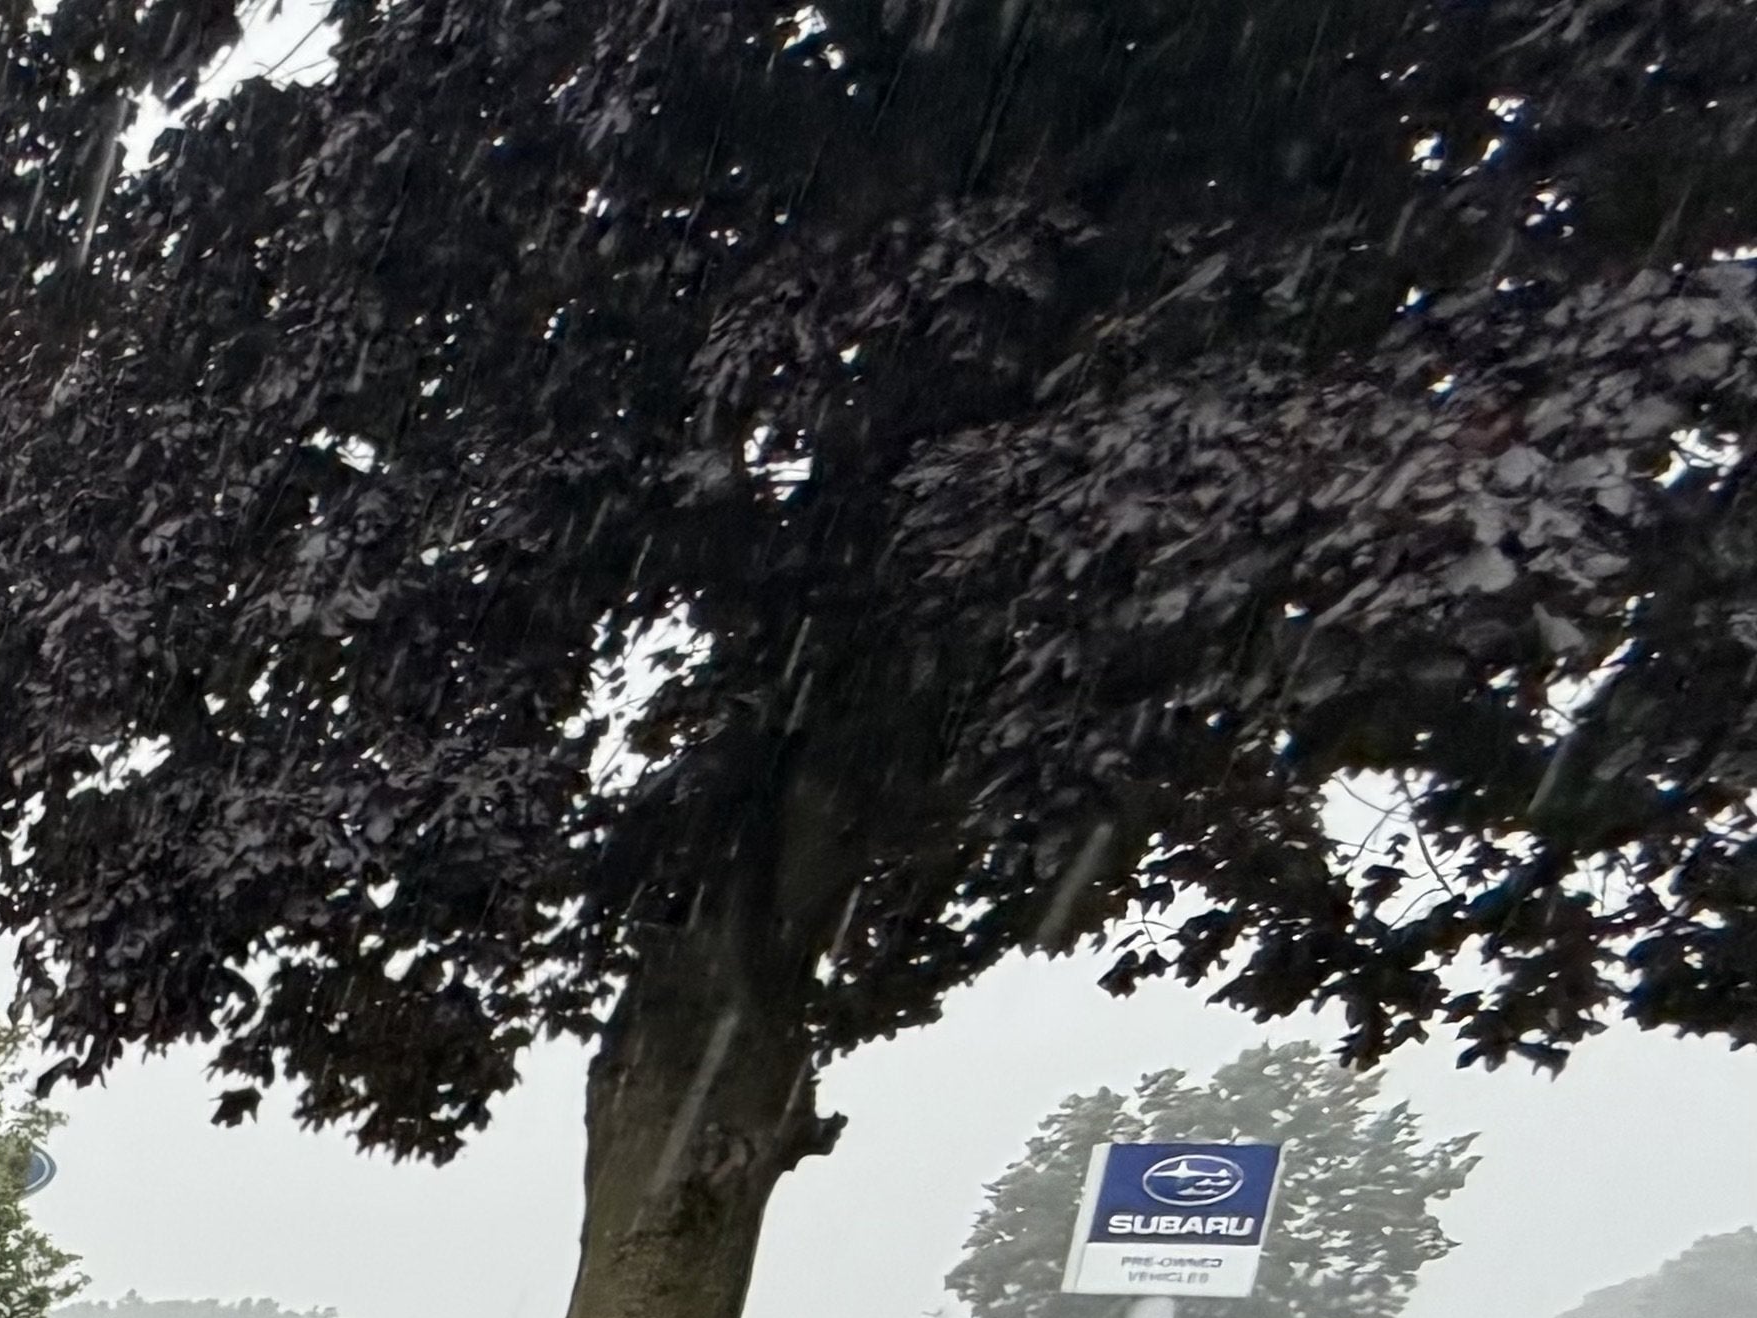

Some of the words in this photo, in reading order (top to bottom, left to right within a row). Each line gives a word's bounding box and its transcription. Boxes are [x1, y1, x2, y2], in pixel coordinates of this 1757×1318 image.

[1107, 1214, 1255, 1236] SUBARU
[1120, 1256, 1223, 1268] PRE-OWNED
[1128, 1271, 1210, 1284] VEHICLES
